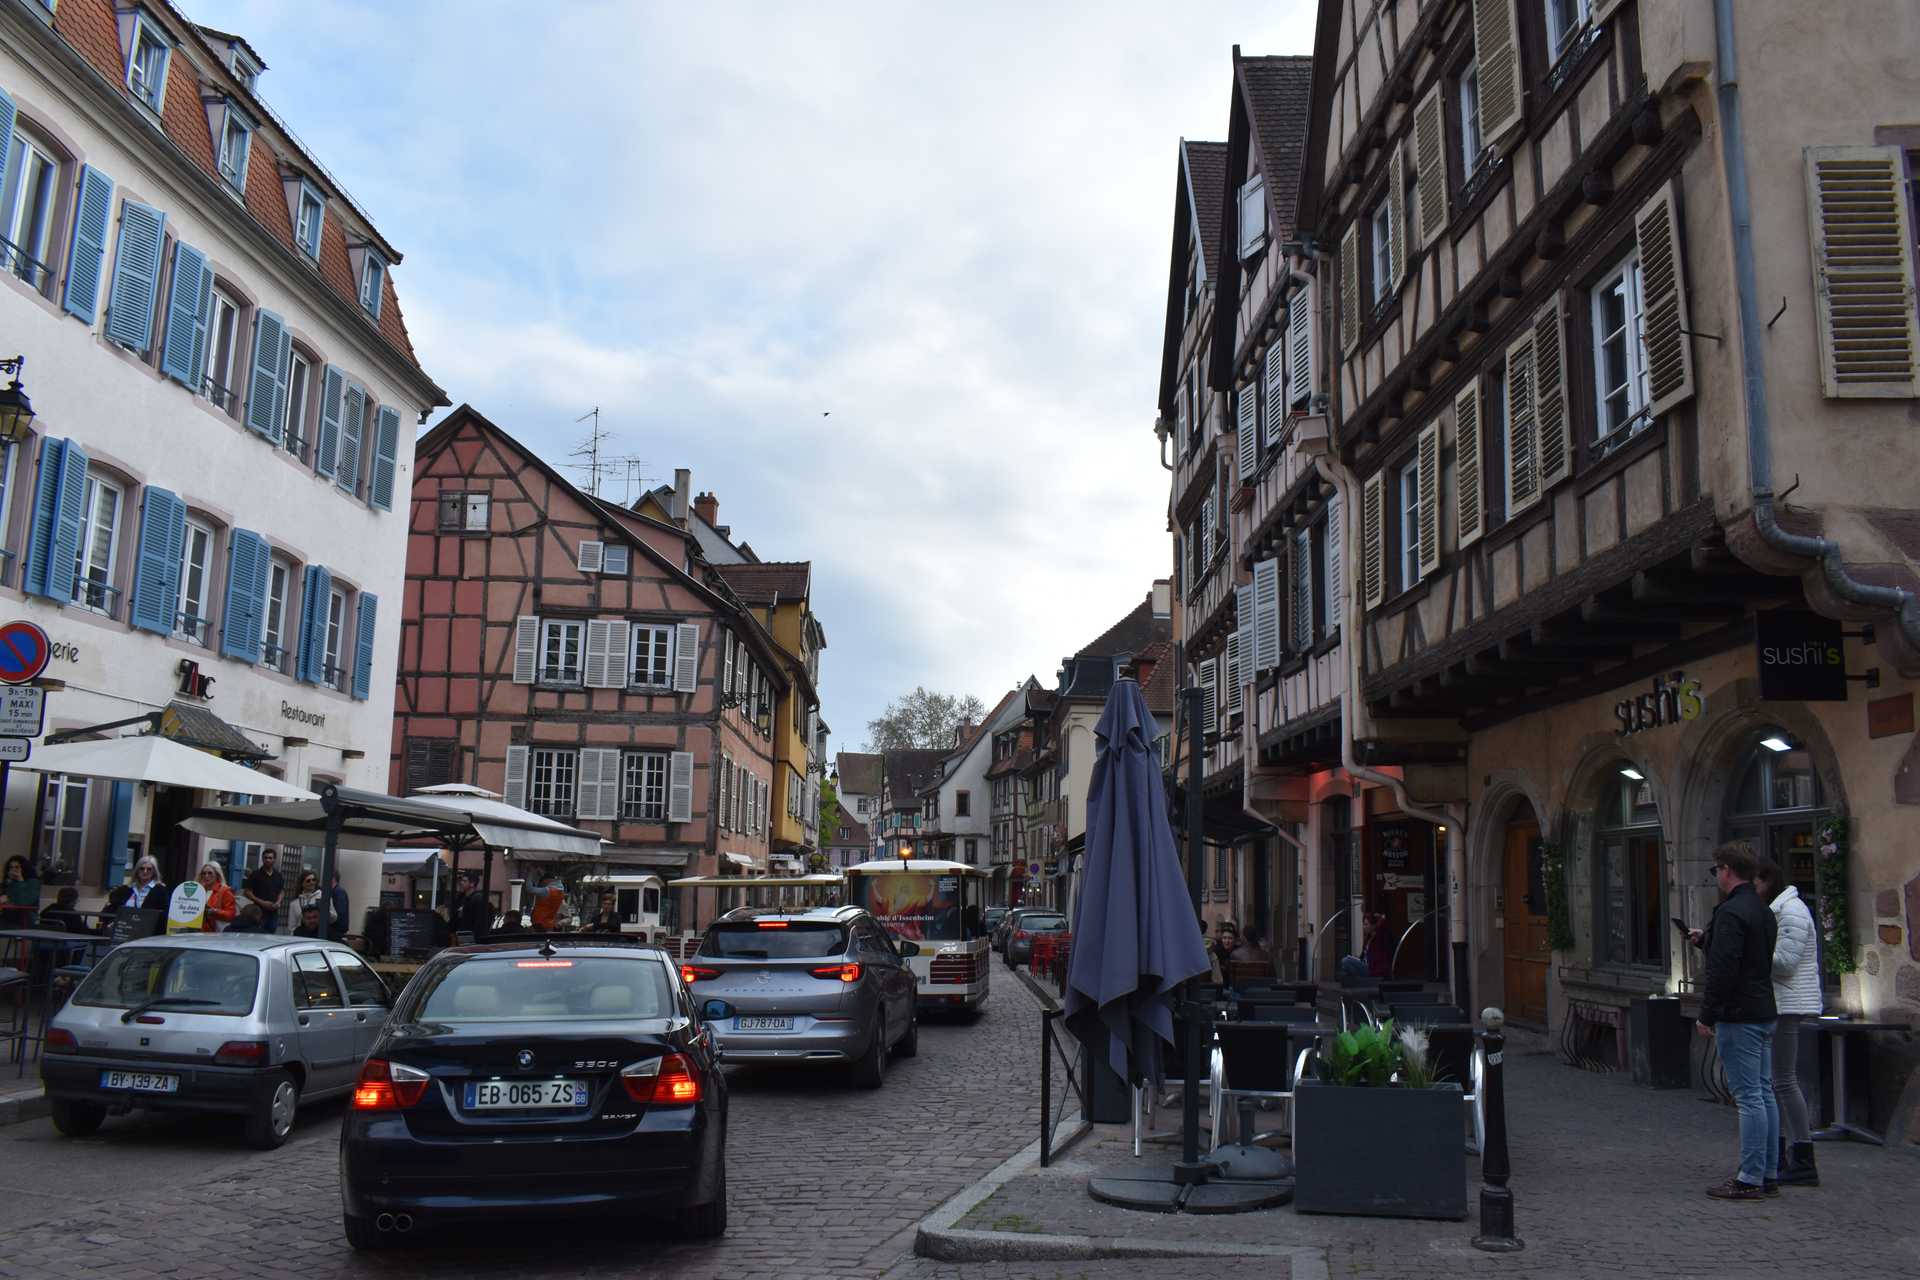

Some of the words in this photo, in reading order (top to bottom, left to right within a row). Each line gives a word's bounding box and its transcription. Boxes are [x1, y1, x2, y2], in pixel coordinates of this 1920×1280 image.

[50, 641, 79, 664] erie
[1762, 640, 1841, 666] sushi's
[281, 700, 326, 729] Restaurant
[478, 1083, 574, 1106] EB-065-ZS
